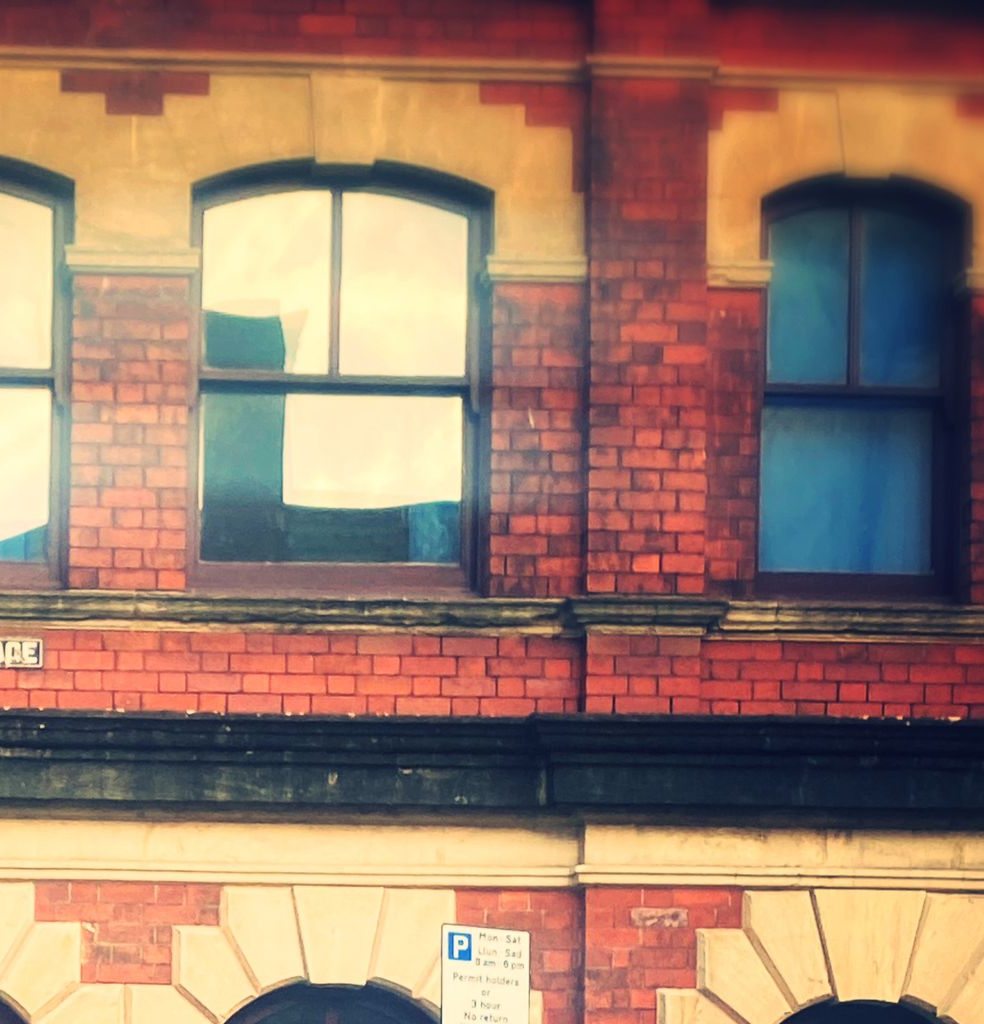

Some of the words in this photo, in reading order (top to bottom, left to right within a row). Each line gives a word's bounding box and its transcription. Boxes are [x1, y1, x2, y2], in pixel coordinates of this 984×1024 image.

[479, 932, 498, 940] Mon
[506, 935, 521, 943] Sat
[453, 934, 469, 959] P
[453, 972, 482, 983] Permit
[486, 975, 519, 987] holders
[480, 1001, 500, 1010] hour
[464, 1012, 477, 1020] No
[480, 1014, 508, 1023] return
